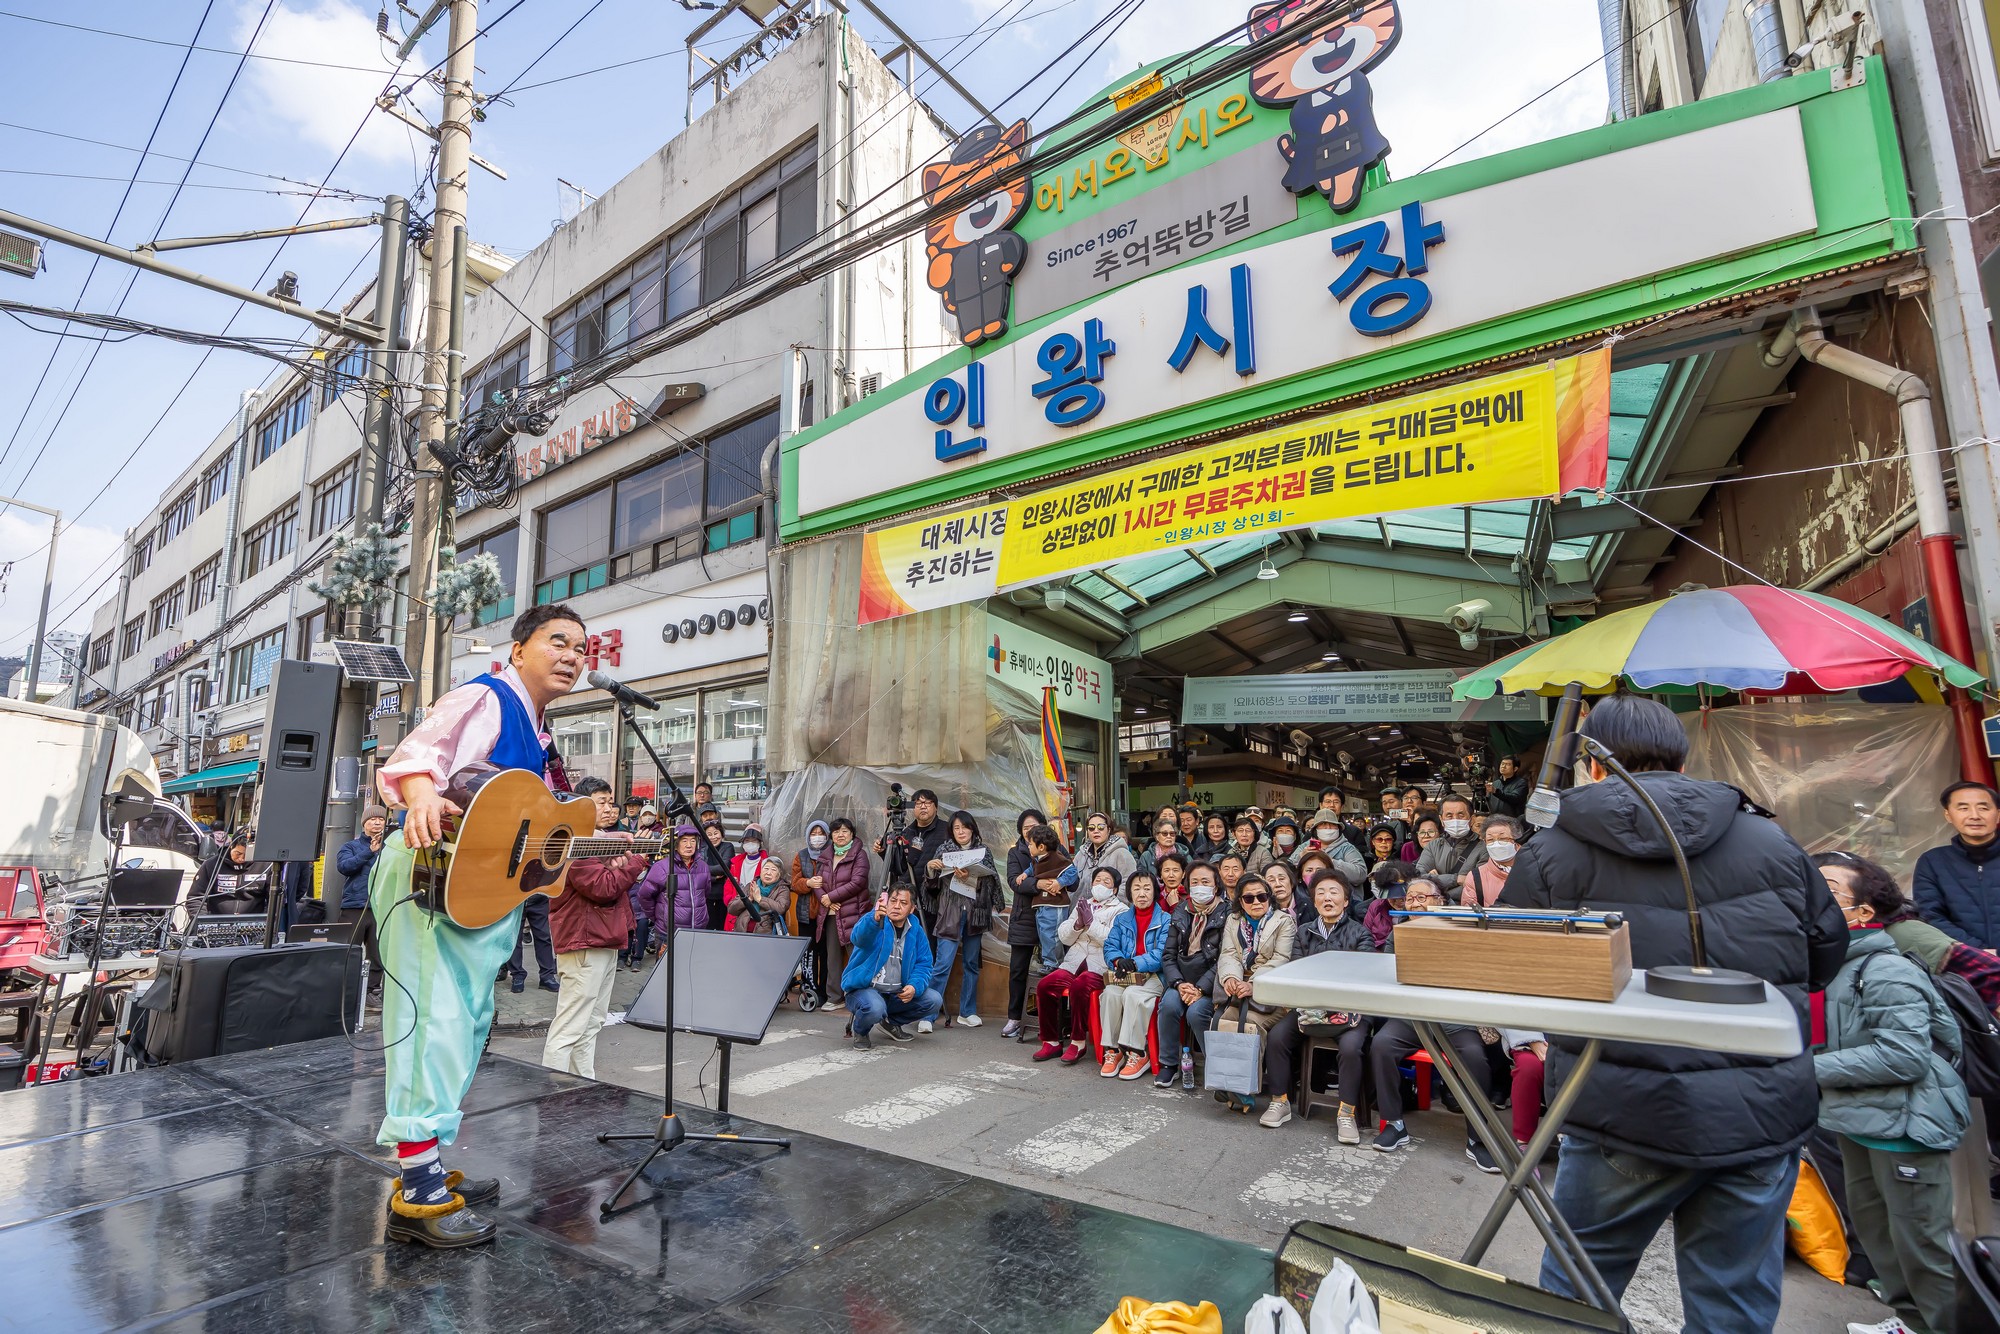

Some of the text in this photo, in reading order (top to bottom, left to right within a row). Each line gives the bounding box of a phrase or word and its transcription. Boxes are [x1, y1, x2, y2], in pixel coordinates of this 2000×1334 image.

[1037, 94, 1253, 213] 어서오시오
[1092, 195, 1250, 282] 추억뚝방길
[675, 386, 688, 397] 2F
[546, 426, 580, 464] 자재
[582, 397, 639, 449] 전시장
[1022, 390, 1524, 530] 인왕시장에서 구매한 고객분들께는 구매금액에
[1042, 514, 1117, 554] 상관없이
[1124, 499, 1176, 534] 1시간
[1343, 442, 1475, 489] 드립니다.
[905, 548, 994, 588] 추진하는
[1009, 650, 1044, 677] 휴베이스
